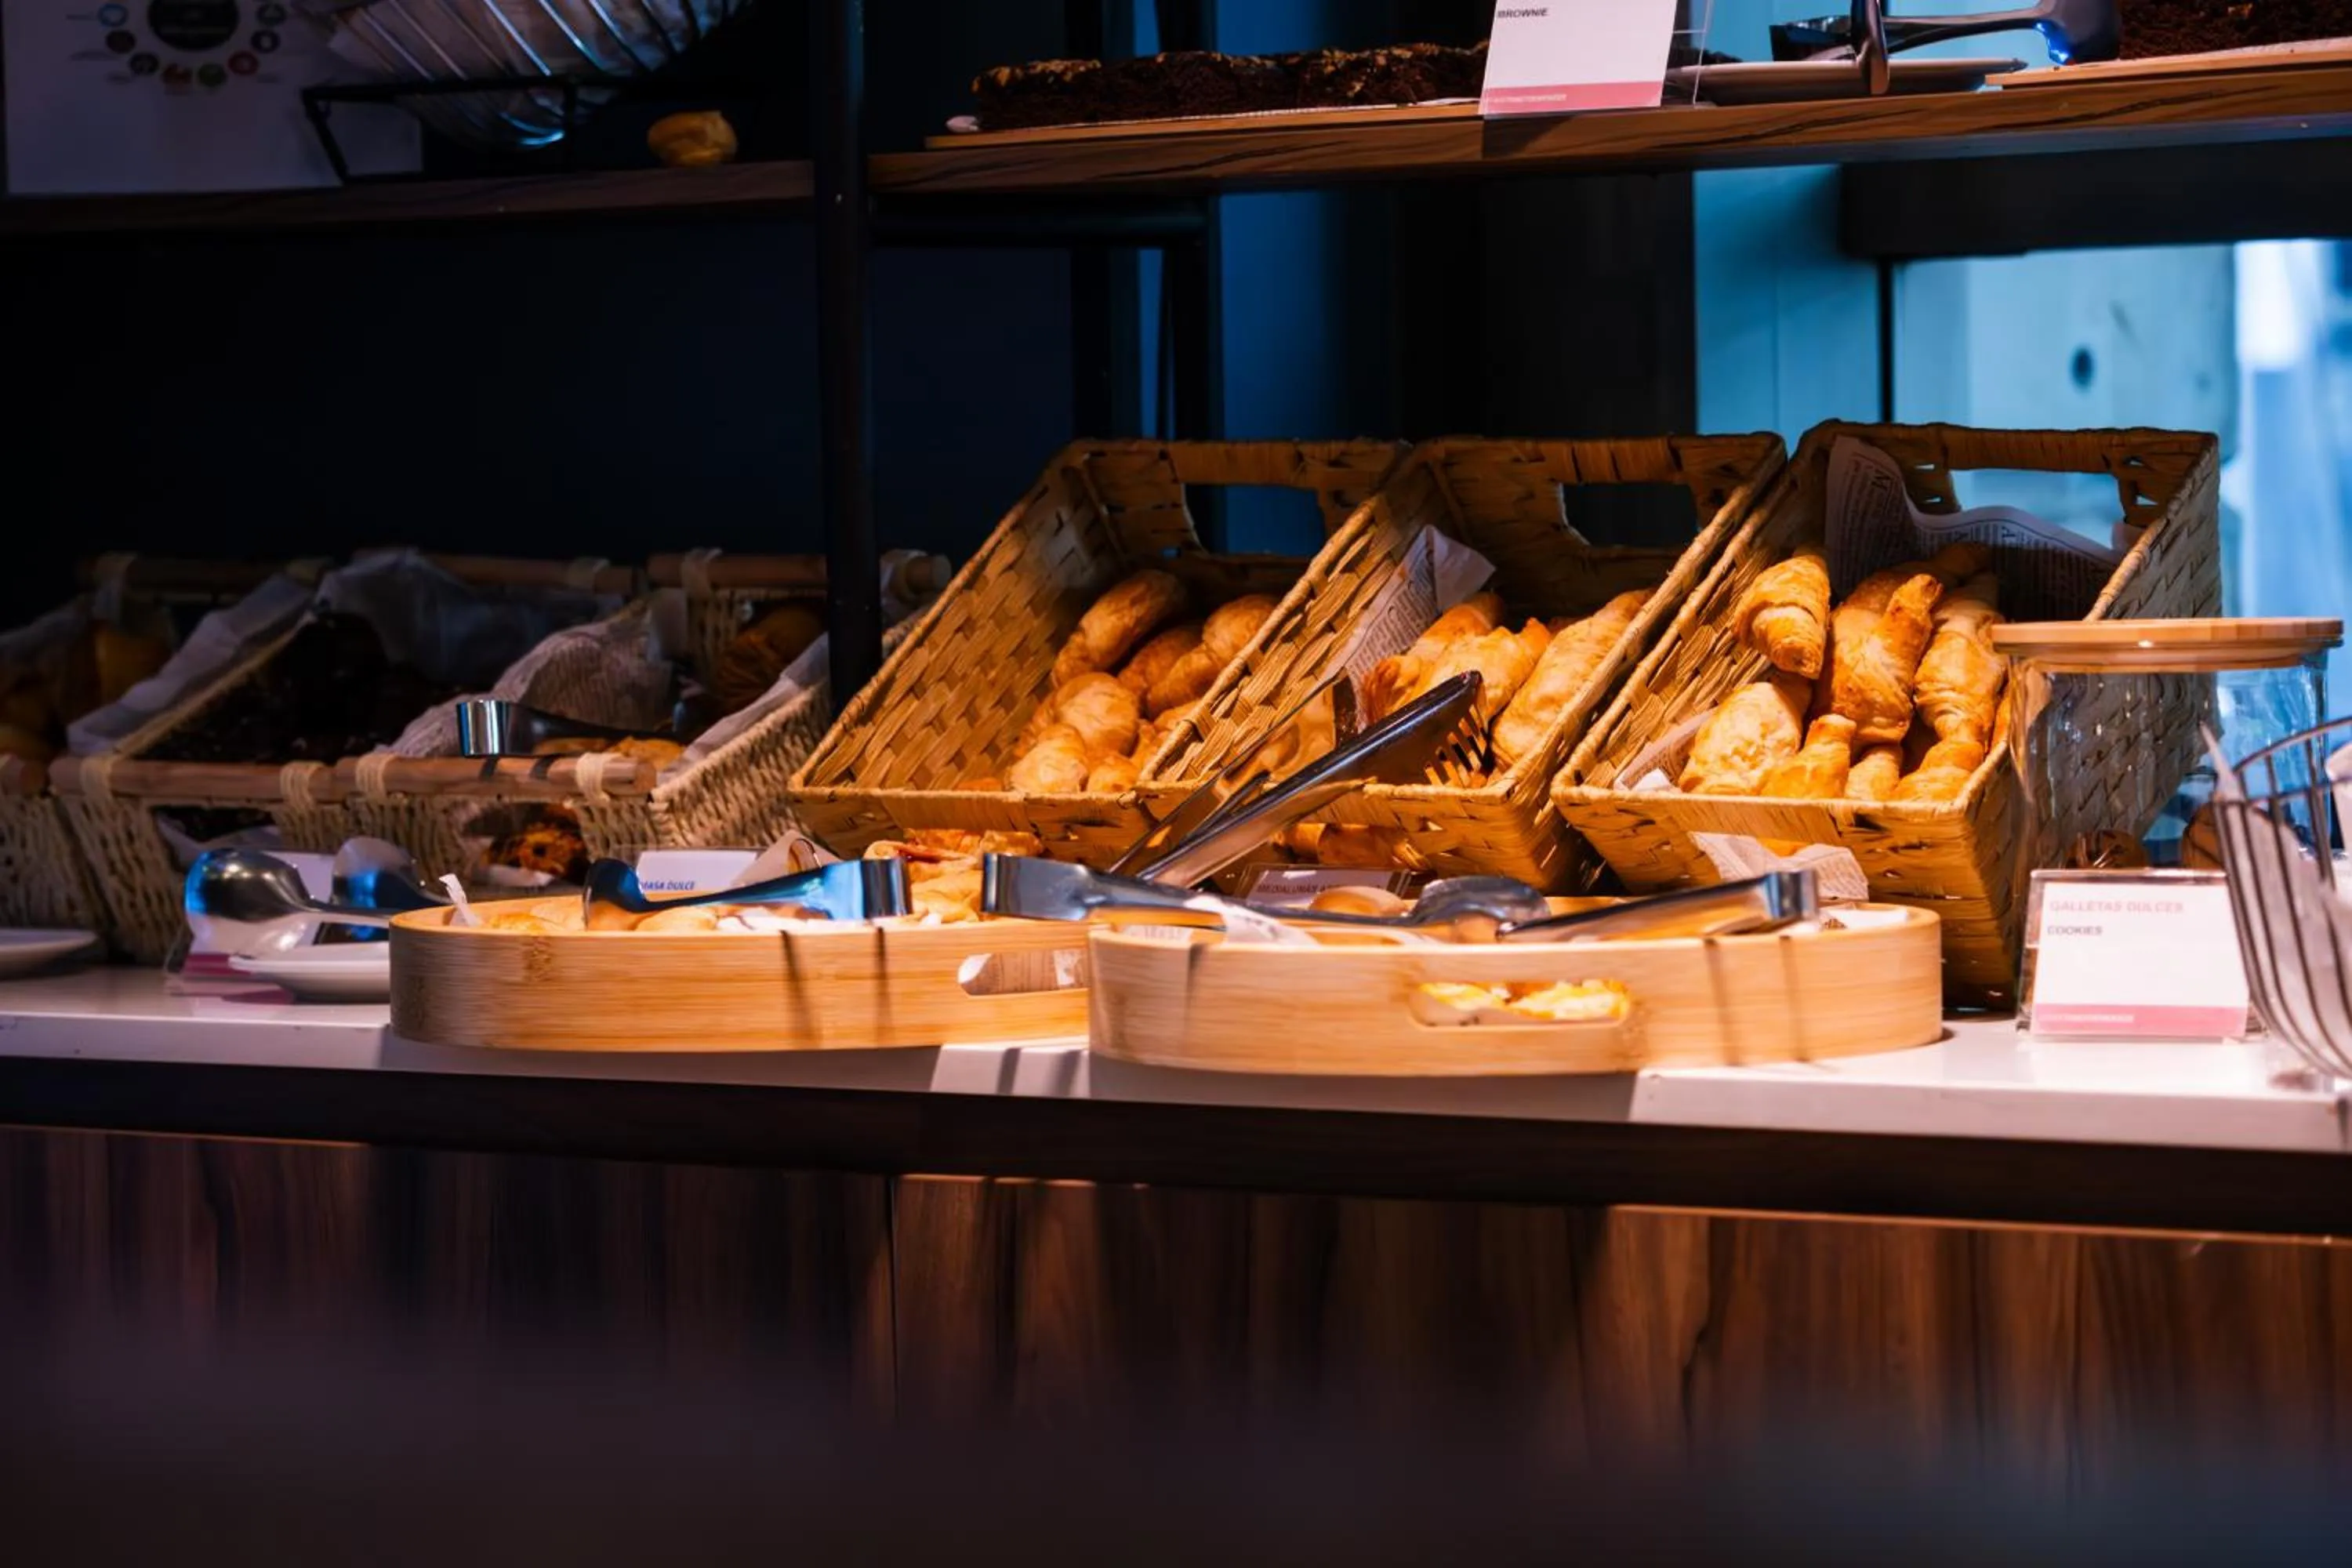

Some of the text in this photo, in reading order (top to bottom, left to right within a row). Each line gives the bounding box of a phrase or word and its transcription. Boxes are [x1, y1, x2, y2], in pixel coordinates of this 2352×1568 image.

[1497, 8, 1549, 18] BROWNIE
[2049, 901, 2184, 913] GALLETAS DULCES
[2047, 925, 2103, 936] COOKIES
